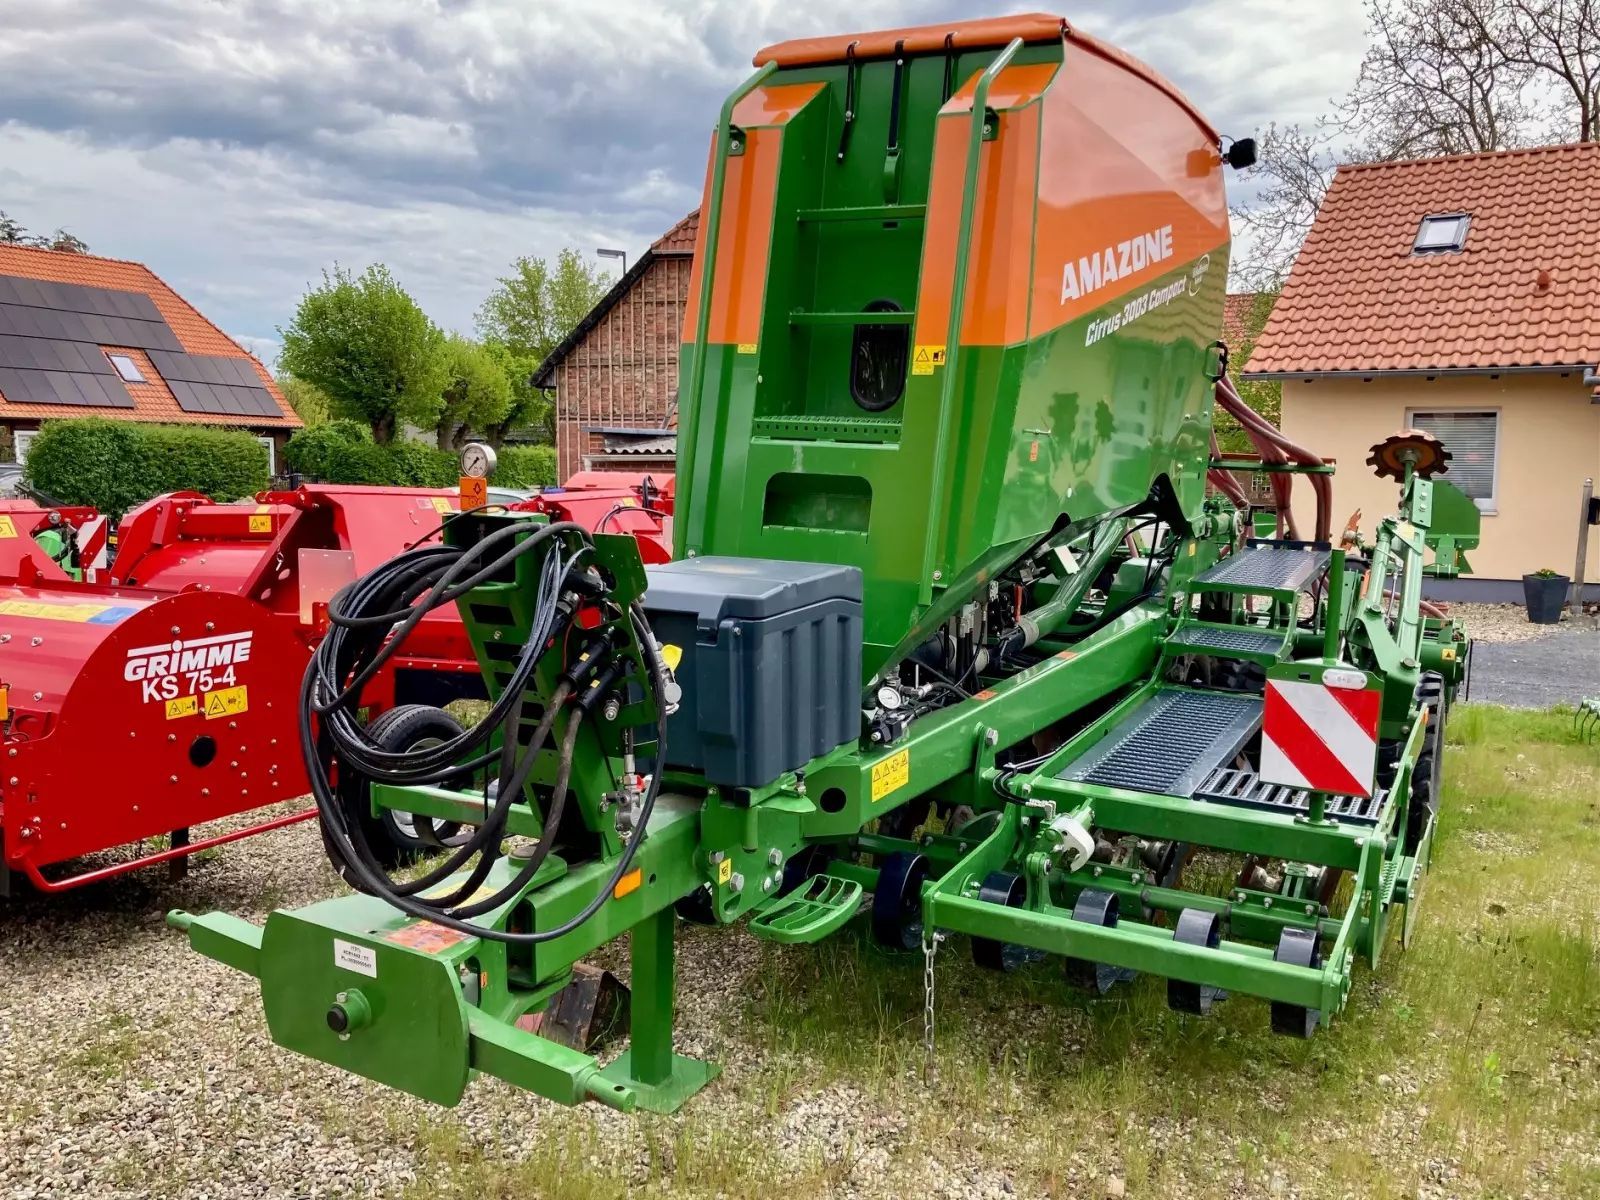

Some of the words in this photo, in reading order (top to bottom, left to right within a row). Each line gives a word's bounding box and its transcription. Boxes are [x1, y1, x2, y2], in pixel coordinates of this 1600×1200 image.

[1061, 224, 1173, 305] AMAZONE
[1085, 313, 1122, 347] Cirrus
[1122, 293, 1149, 326] 3003
[1148, 274, 1187, 311] Compact
[142, 675, 179, 704] KS
[185, 665, 237, 695] 75-4
